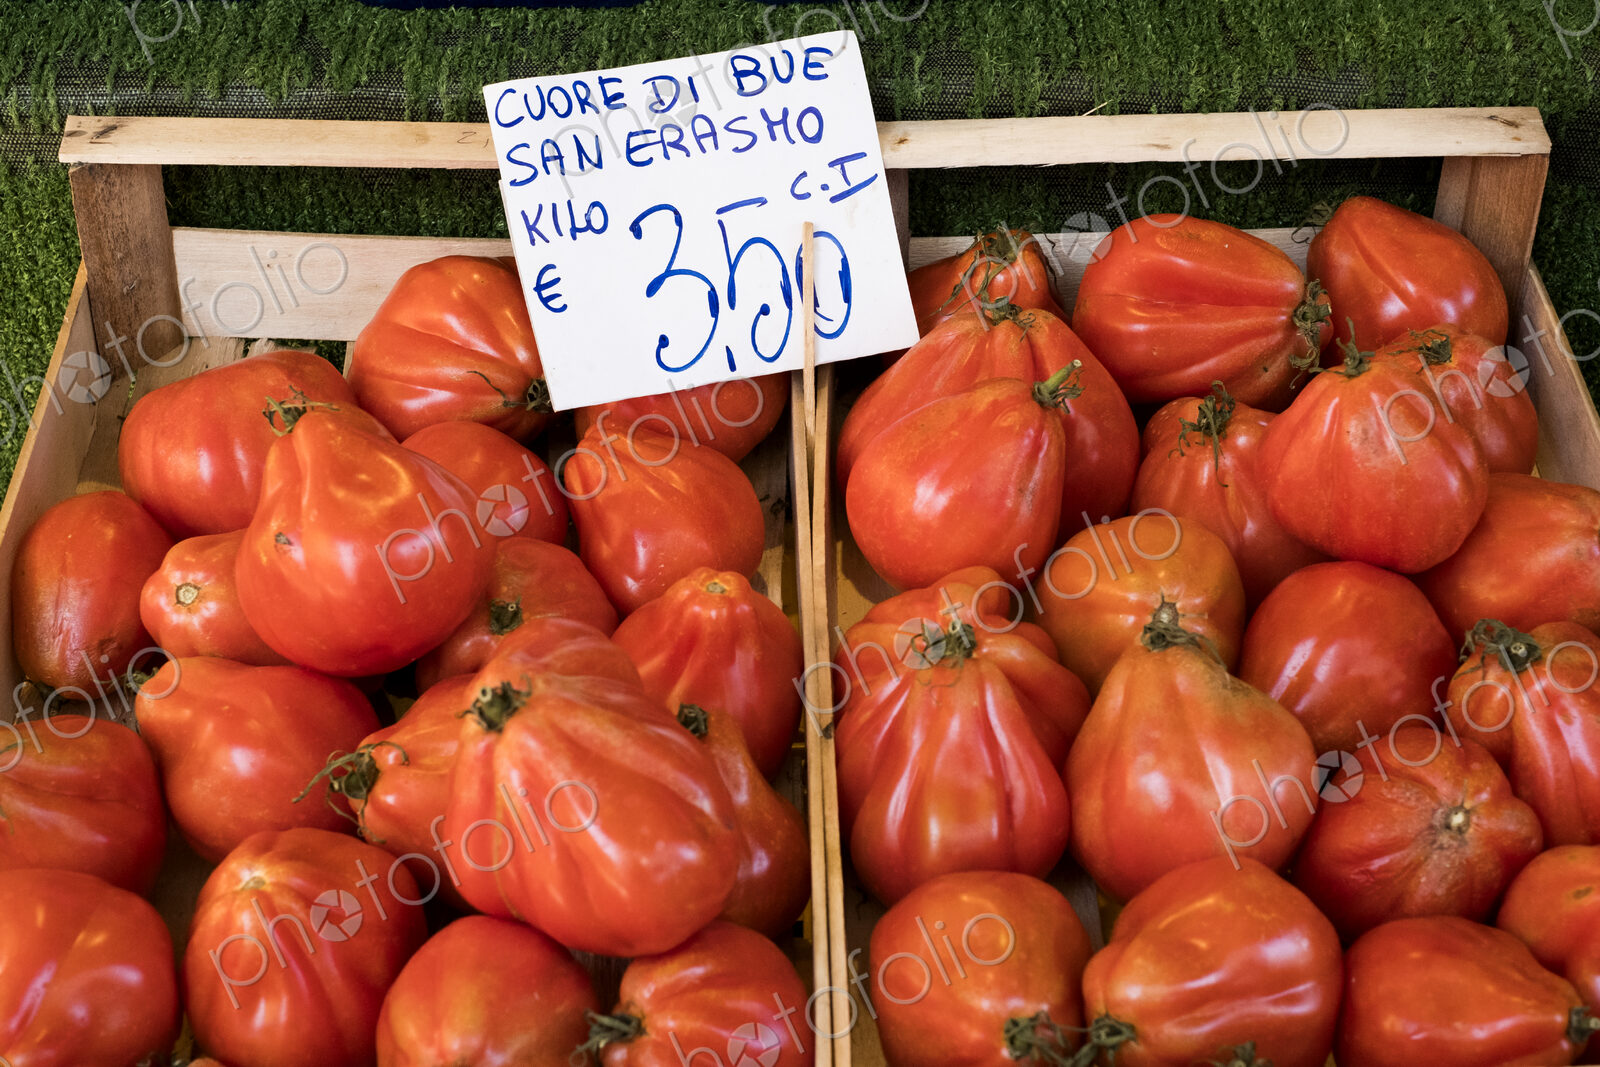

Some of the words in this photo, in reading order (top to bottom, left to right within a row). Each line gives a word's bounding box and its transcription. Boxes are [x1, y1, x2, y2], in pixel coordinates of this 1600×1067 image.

[495, 76, 627, 128] CUORE
[642, 75, 700, 114] DI
[730, 46, 834, 97] BUE
[506, 134, 603, 187] SAN
[626, 106, 824, 167] ERASMO
[521, 200, 609, 246] KILO
[533, 264, 568, 313] €
[629, 196, 852, 373] 3,50
